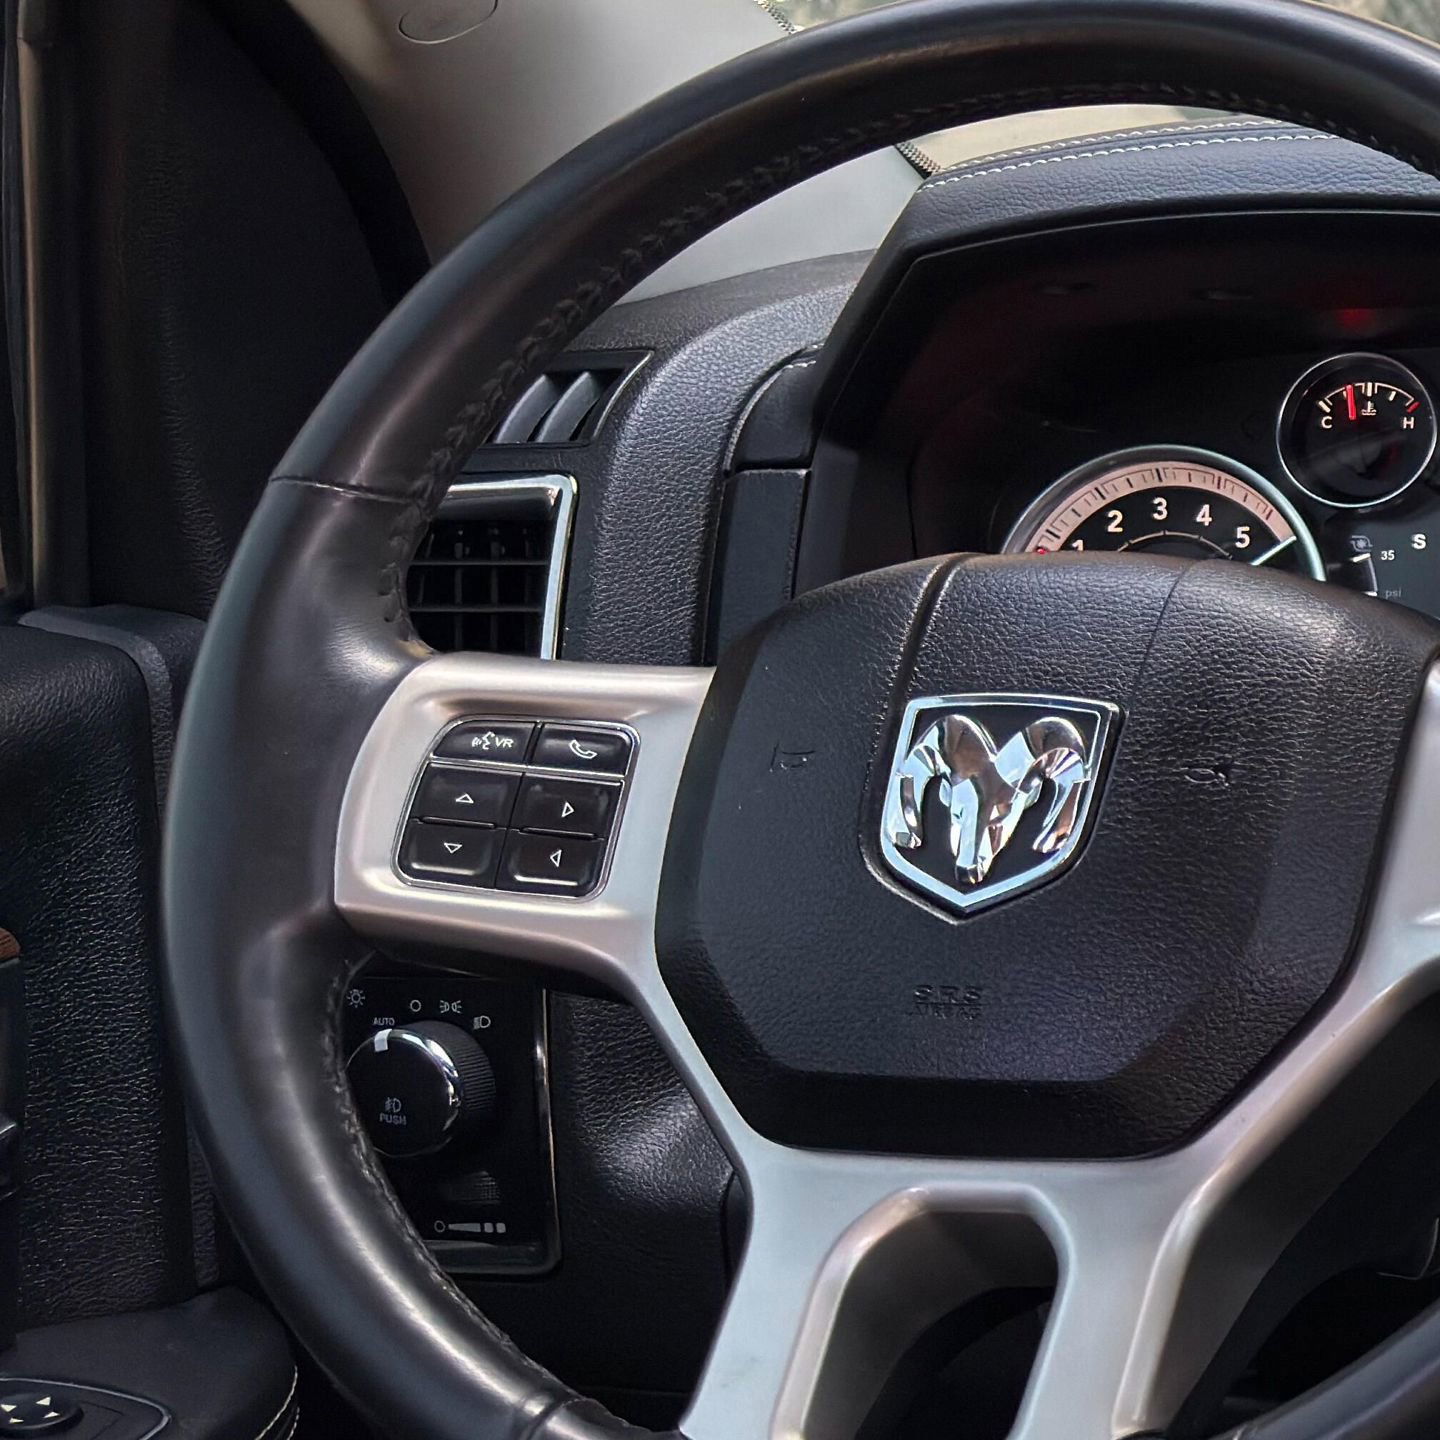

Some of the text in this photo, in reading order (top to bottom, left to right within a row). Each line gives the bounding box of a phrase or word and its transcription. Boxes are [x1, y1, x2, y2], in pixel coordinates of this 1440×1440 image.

[1320, 416, 1333, 430] C
[1402, 416, 1415, 430] H
[1152, 496, 1169, 521] 3
[1195, 503, 1213, 527] 4
[1106, 510, 1124, 534] 2
[1235, 525, 1251, 550] 5
[1411, 533, 1427, 551] S
[1380, 550, 1396, 562] 35
[494, 736, 515, 749] VR
[372, 1016, 396, 1027] AUTO
[378, 1112, 408, 1126] PUSH
